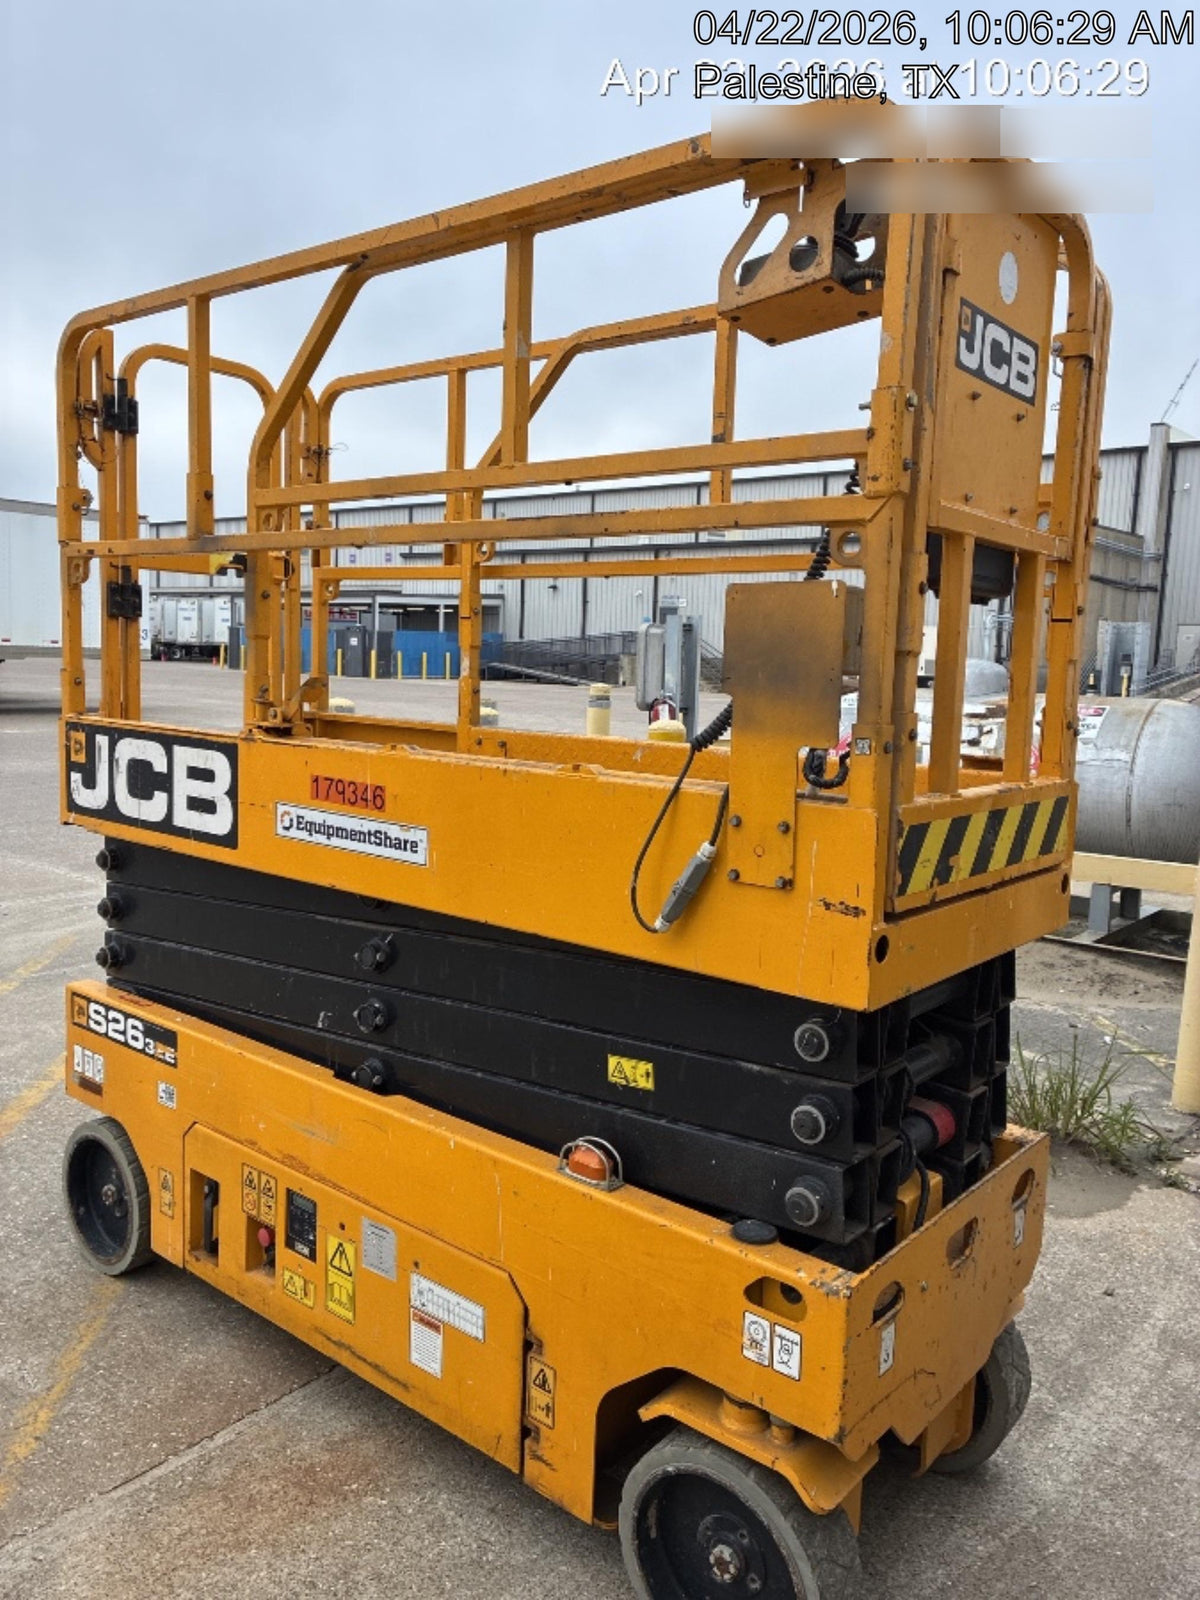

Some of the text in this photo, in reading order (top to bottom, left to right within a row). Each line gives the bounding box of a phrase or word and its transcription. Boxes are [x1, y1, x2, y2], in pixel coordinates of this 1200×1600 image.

[959, 313, 1038, 398] JCB
[70, 733, 235, 836] JCB
[312, 776, 386, 810] 179346
[296, 815, 420, 854] EquipmentShare
